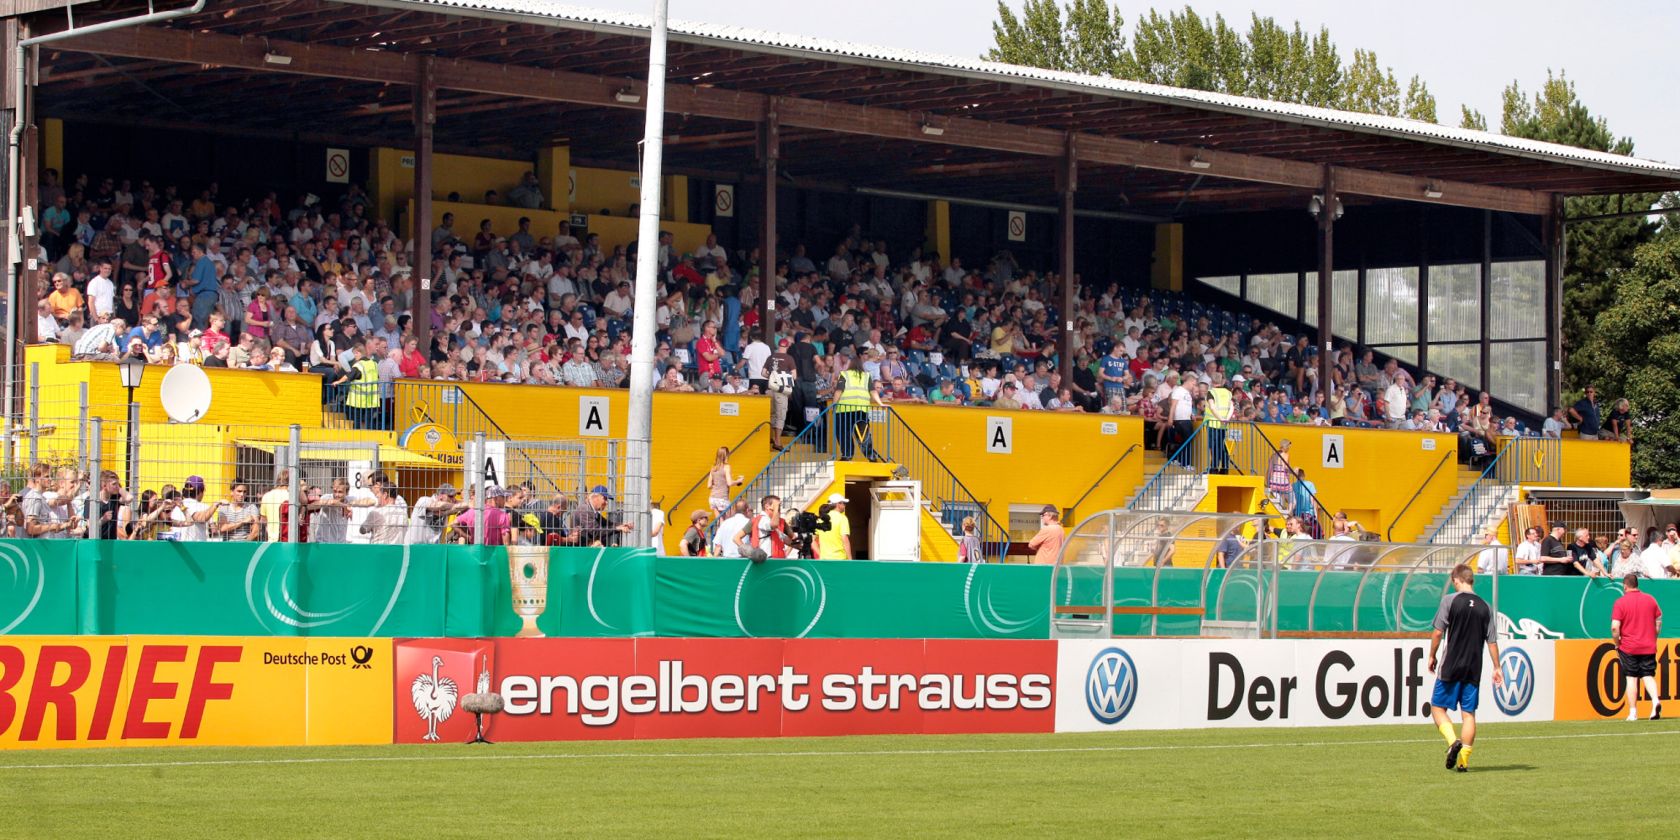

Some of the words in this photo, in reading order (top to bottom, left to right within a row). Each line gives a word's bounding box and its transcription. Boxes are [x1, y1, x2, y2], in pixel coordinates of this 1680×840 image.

[585, 406, 603, 430] A
[992, 426, 1007, 447] A
[1327, 443, 1339, 463] A
[485, 457, 499, 485] A
[264, 651, 318, 665] Deutsche
[321, 652, 347, 665] Post
[1207, 651, 1297, 721] Der
[1315, 647, 1431, 720] Golf.
[1587, 642, 1680, 717] Coti
[500, 660, 810, 726] engelbert
[821, 666, 1053, 711] strauss
